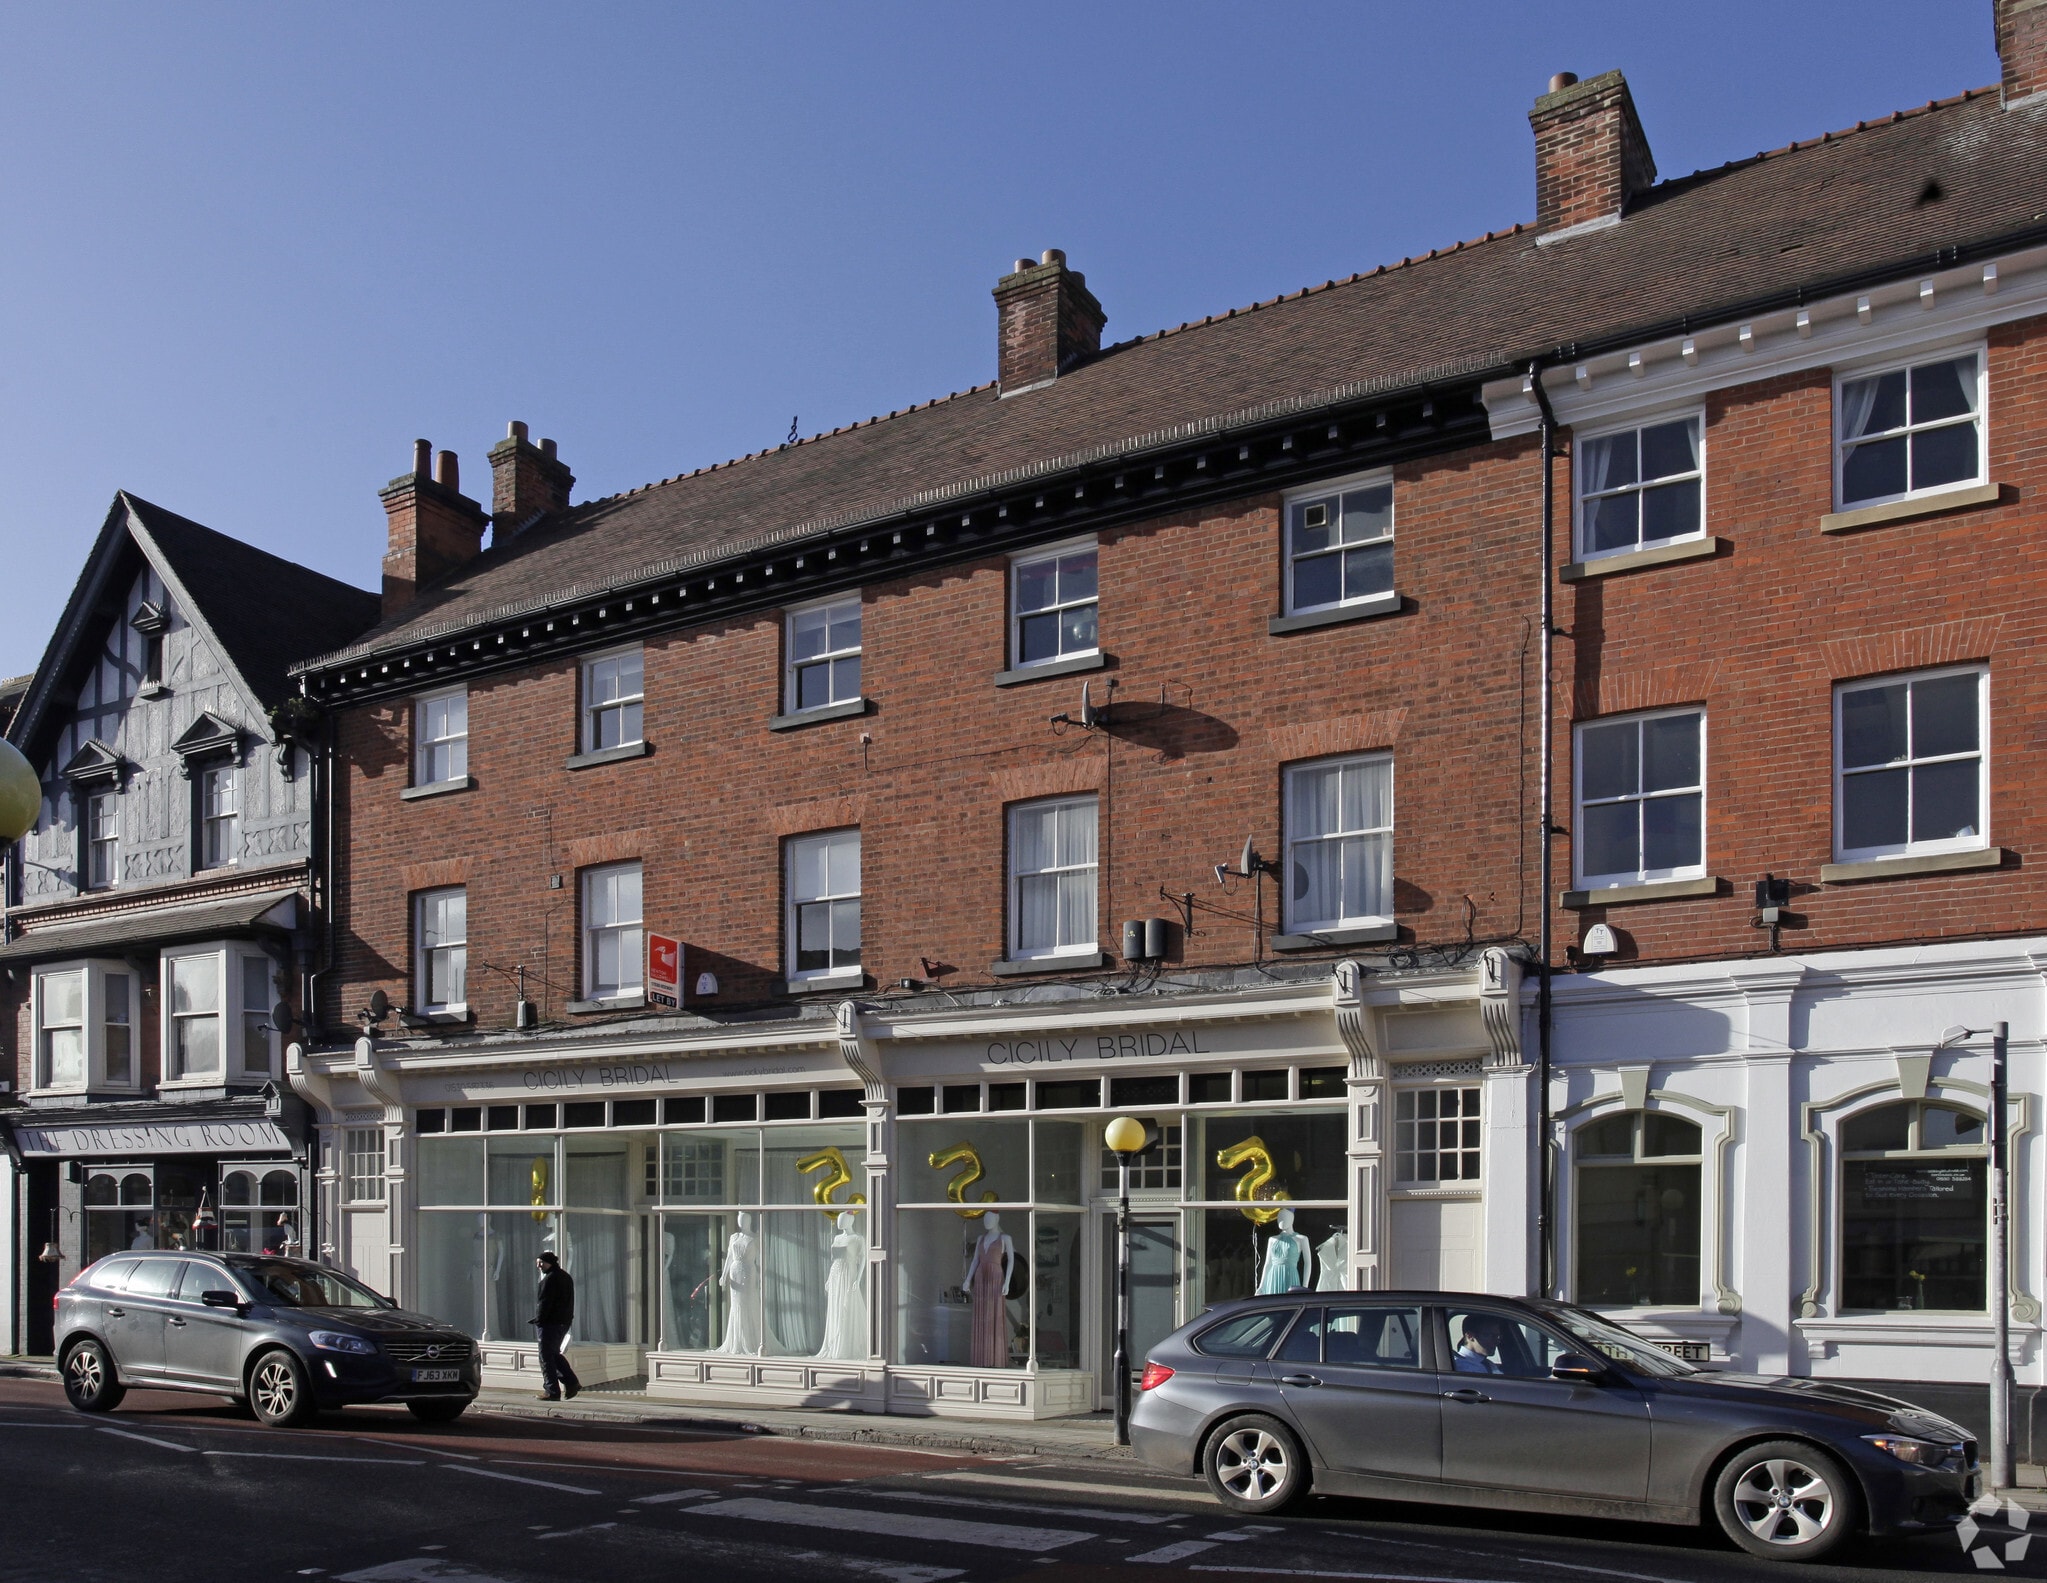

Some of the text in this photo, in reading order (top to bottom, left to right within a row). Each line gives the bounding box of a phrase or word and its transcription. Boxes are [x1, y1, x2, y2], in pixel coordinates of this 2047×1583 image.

[652, 993, 676, 1007] LET BY
[987, 1031, 1210, 1064] CICILY BRIDAL
[523, 1064, 679, 1090] CICILY BRIDAL
[22, 1122, 281, 1151] THE DRESSING ROOM
[1658, 1346, 1703, 1359] EET
[417, 1370, 440, 1380] FJ63
